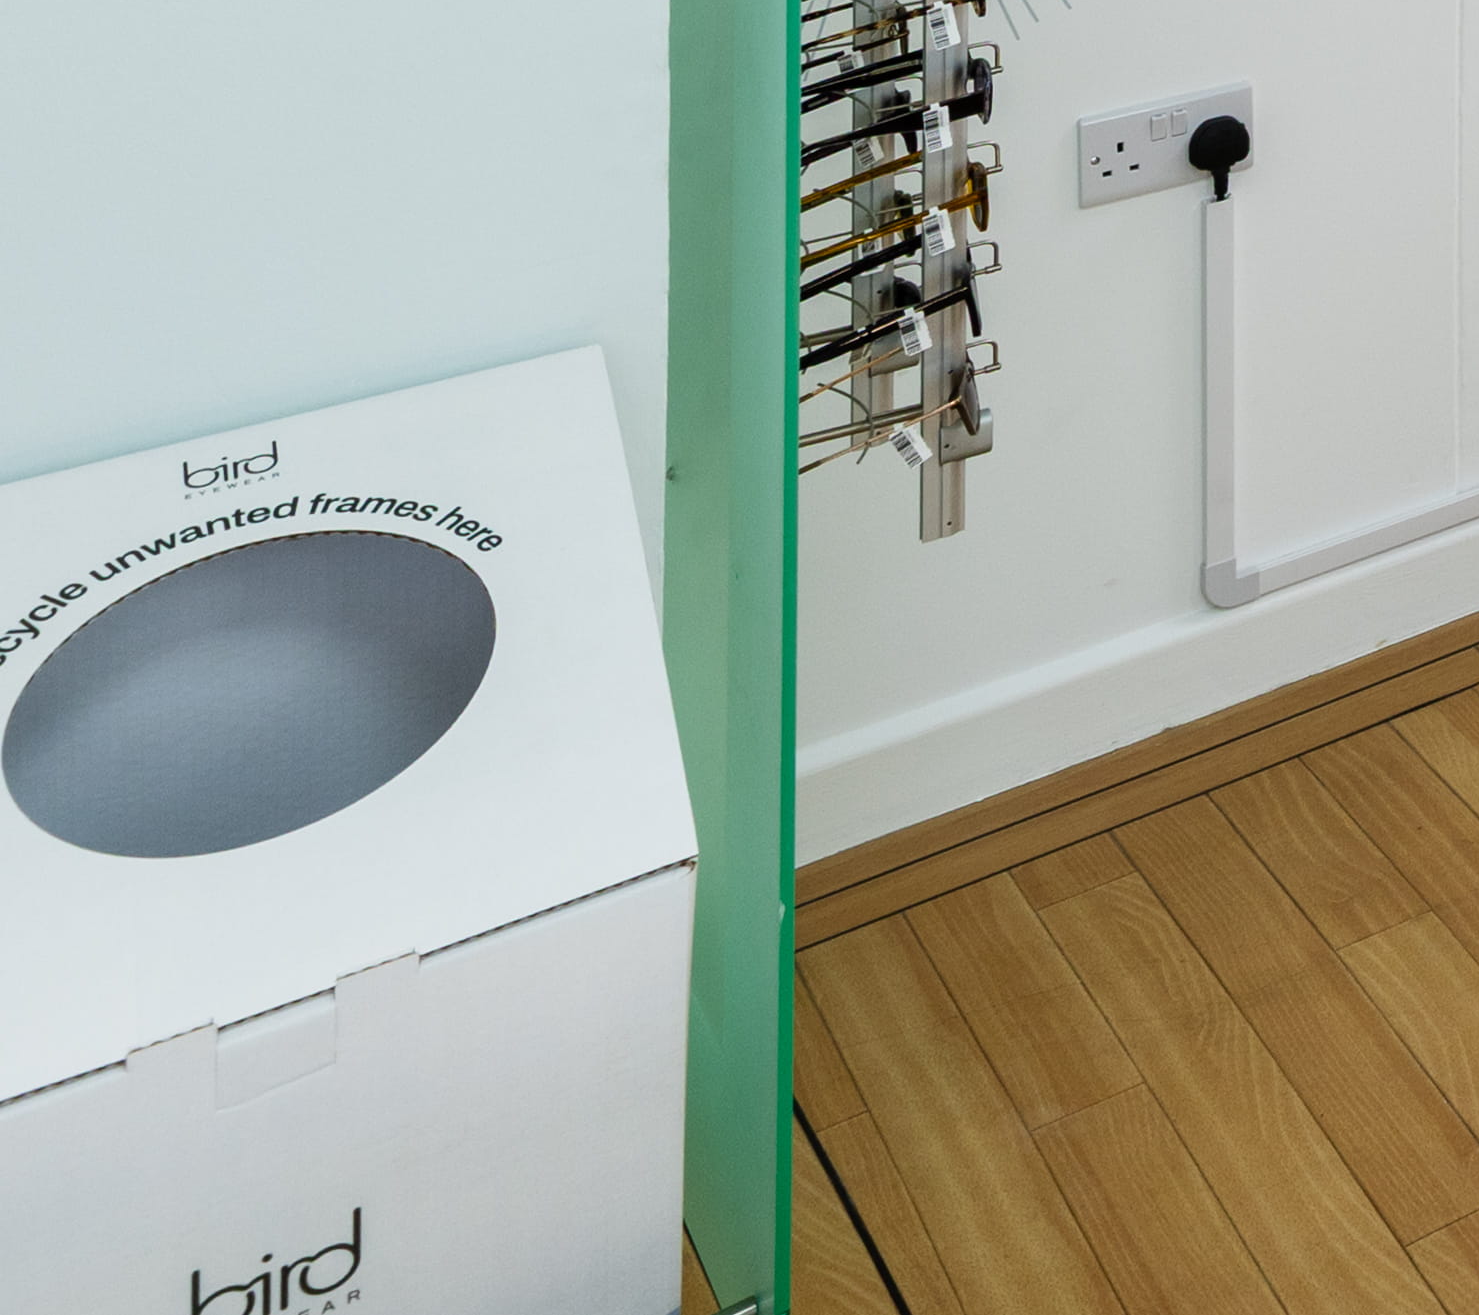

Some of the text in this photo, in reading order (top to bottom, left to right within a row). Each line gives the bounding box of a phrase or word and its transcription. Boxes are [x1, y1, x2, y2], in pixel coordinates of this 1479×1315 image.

[183, 440, 279, 490] bird
[184, 471, 281, 500] EYEWEAR
[0, 492, 504, 669] cycle unwanted frames here
